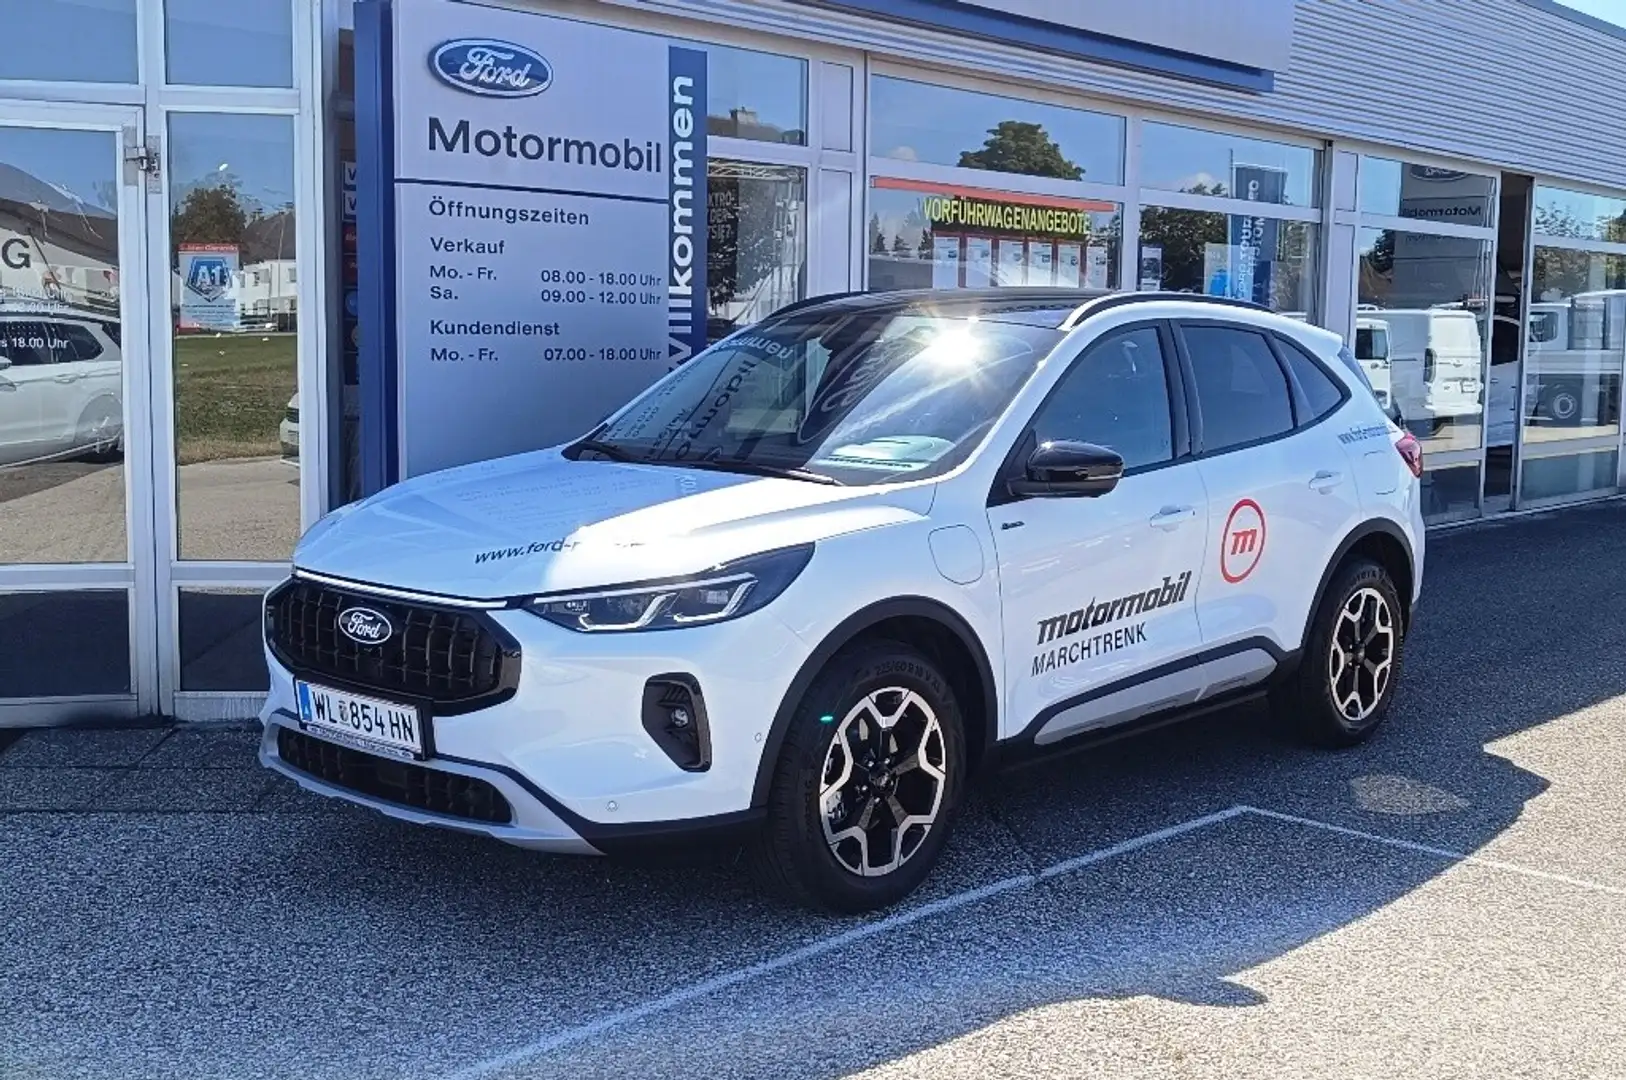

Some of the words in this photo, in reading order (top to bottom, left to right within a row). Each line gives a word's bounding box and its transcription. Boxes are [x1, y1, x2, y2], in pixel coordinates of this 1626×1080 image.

[459, 47, 532, 87] Ford
[427, 116, 661, 173] Motormobil
[429, 196, 589, 225] Öffnungszeiten
[923, 196, 1092, 235] VORFÜHRWAGENANGEBOTE
[430, 237, 505, 255] Verkauf
[430, 265, 464, 280] Mo.
[477, 266, 498, 281] Fr.
[541, 269, 587, 285] 08.00
[599, 272, 637, 286] 18.00
[640, 272, 662, 287] Uhr
[429, 285, 460, 301] Sa.
[541, 289, 587, 304] 09.00
[599, 291, 637, 305] 12.00
[640, 291, 662, 305] Uhr
[429, 319, 561, 336] Kundendienst
[12, 336, 44, 349] 18.00
[47, 337, 70, 349] Uhr
[430, 348, 465, 362] Mo.
[478, 348, 499, 362] Fr.
[543, 347, 587, 362] 07.00
[599, 347, 637, 361] 18.00
[640, 347, 662, 361] Uhr
[1036, 570, 1193, 646] motormobil
[347, 611, 381, 639] Ford
[1030, 621, 1148, 678] MARCHTRENK
[311, 690, 338, 724] WL
